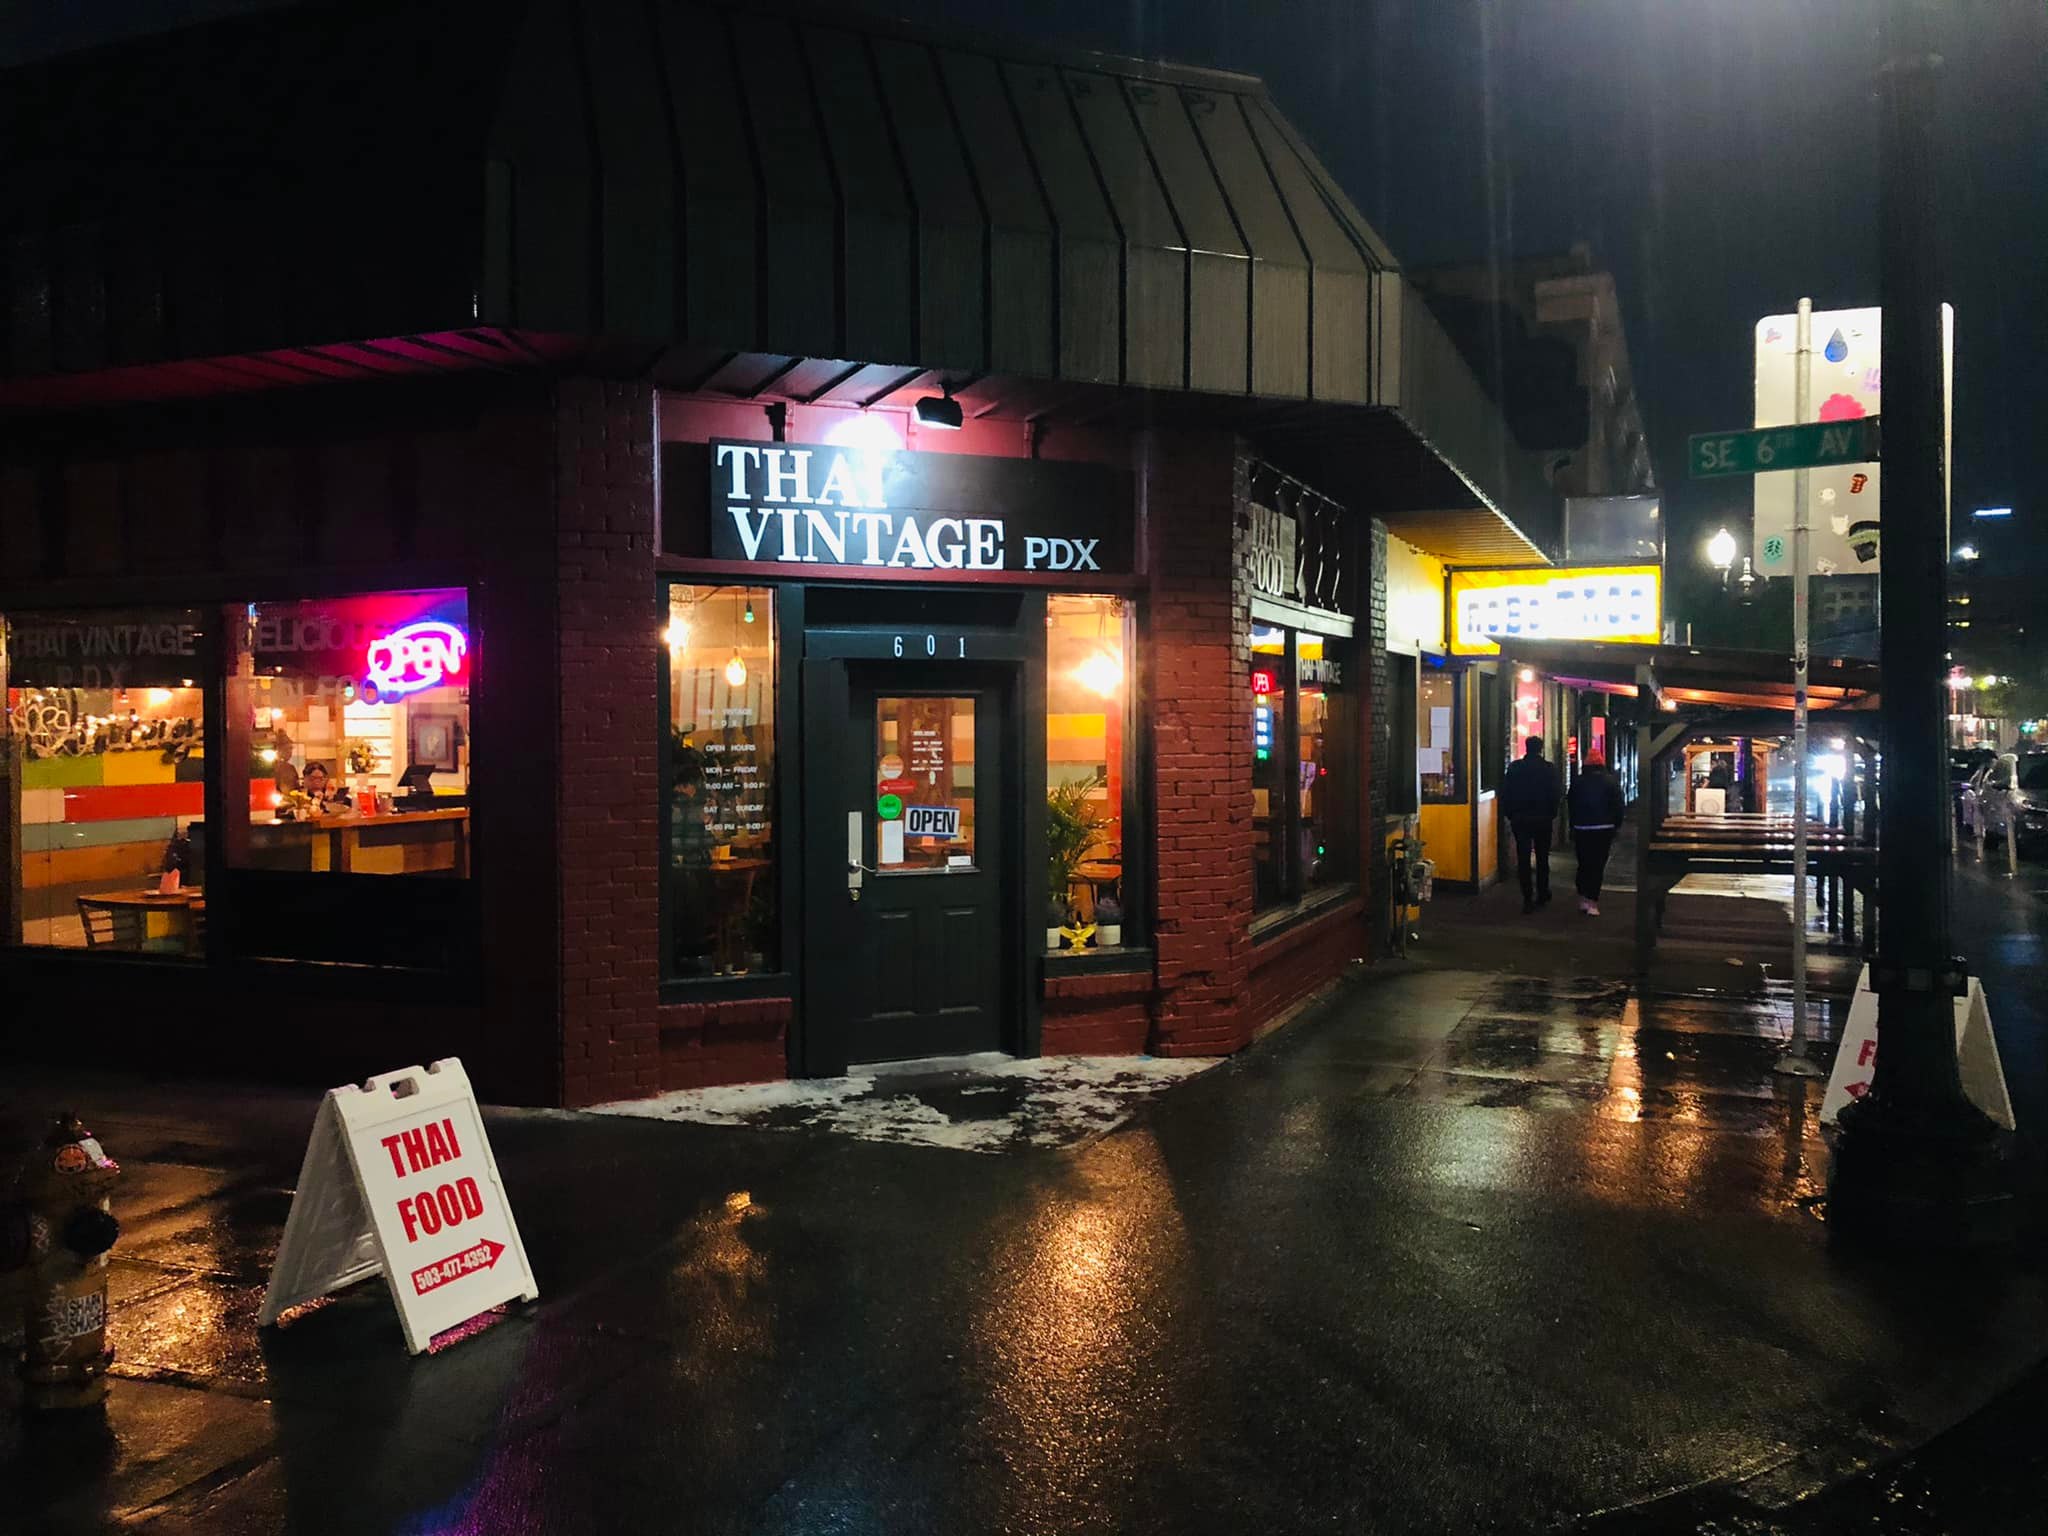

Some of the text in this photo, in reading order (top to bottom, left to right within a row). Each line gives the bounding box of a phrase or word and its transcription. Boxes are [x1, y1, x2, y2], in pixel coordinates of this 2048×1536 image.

[1700, 426, 1852, 470] SE 6TH AV
[716, 443, 887, 509] THAI
[727, 505, 1102, 572] VINTAGE PDX
[76, 623, 196, 657] VINTAGE
[368, 632, 464, 679] OPEN
[705, 744, 757, 753] OPEN HOURS
[908, 809, 956, 834] OPEN
[380, 1117, 462, 1179] THAI
[396, 1176, 484, 1244] FOOD
[414, 1244, 494, 1291] 503-477-4352
